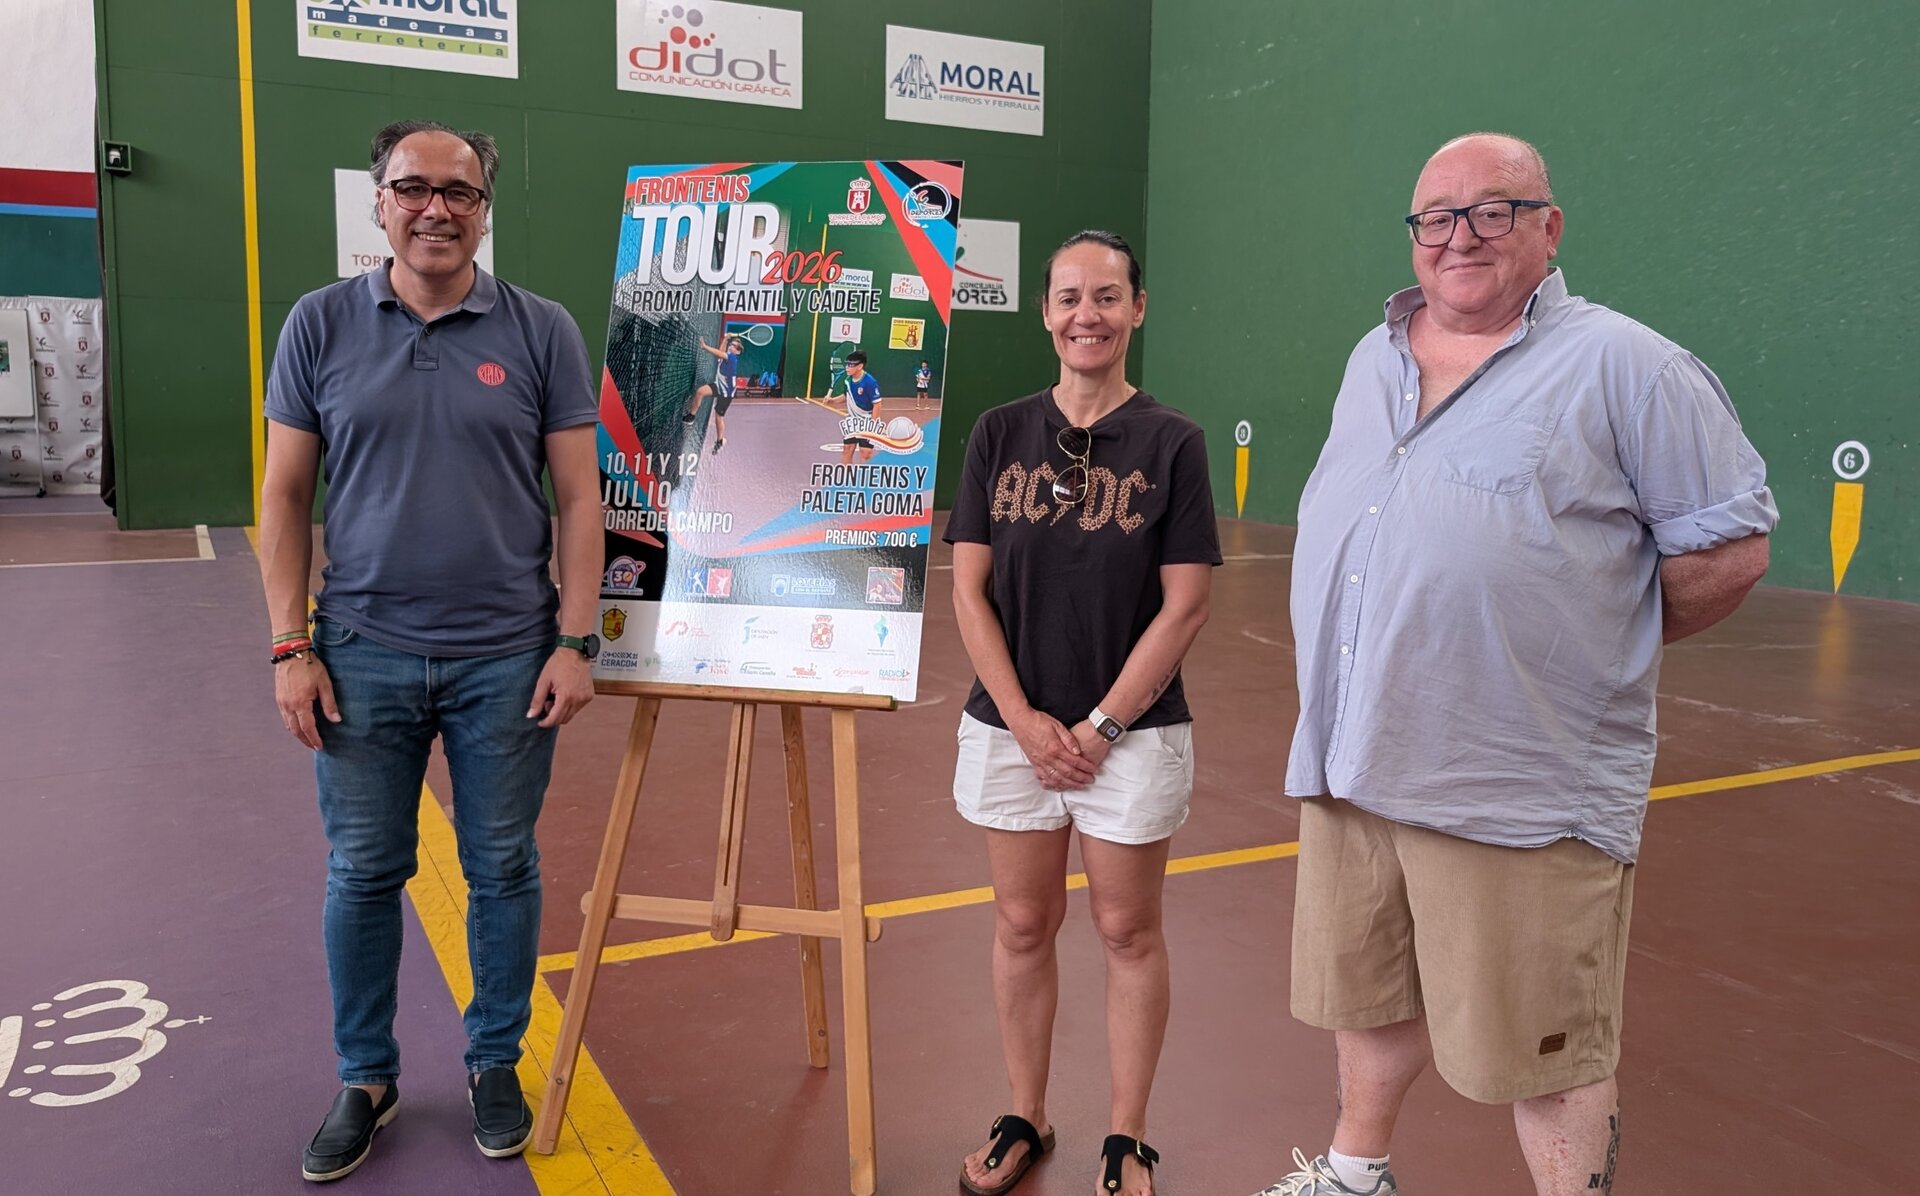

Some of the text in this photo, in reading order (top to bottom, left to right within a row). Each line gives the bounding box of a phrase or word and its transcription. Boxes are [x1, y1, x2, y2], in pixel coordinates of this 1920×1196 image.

[312, 9, 503, 40] maderas
[629, 41, 791, 86] didot
[629, 71, 791, 97] COMUNICACIÓN GRÁFICA
[940, 61, 1040, 96] MORAL
[940, 94, 982, 105] HIERROS
[993, 100, 1040, 111] FERRALLA
[635, 175, 750, 204] FRONTENIS
[633, 202, 844, 286] TOUR 2026
[845, 274, 870, 283] moral
[631, 289, 882, 313] PROMO INFANTIL Y CADETE
[952, 288, 1007, 306] ORTES
[659, 453, 671, 475] Y
[677, 453, 699, 476] 12
[1843, 452, 1855, 469] 6
[811, 464, 928, 489] FRONTENIS Y
[601, 479, 672, 508] JULIO
[801, 490, 924, 517] PALETA GOMA
[603, 509, 733, 533] ORREDELCAMPO
[825, 529, 918, 548] PREMIOS: 700 €
[601, 659, 638, 668] CERACOM
